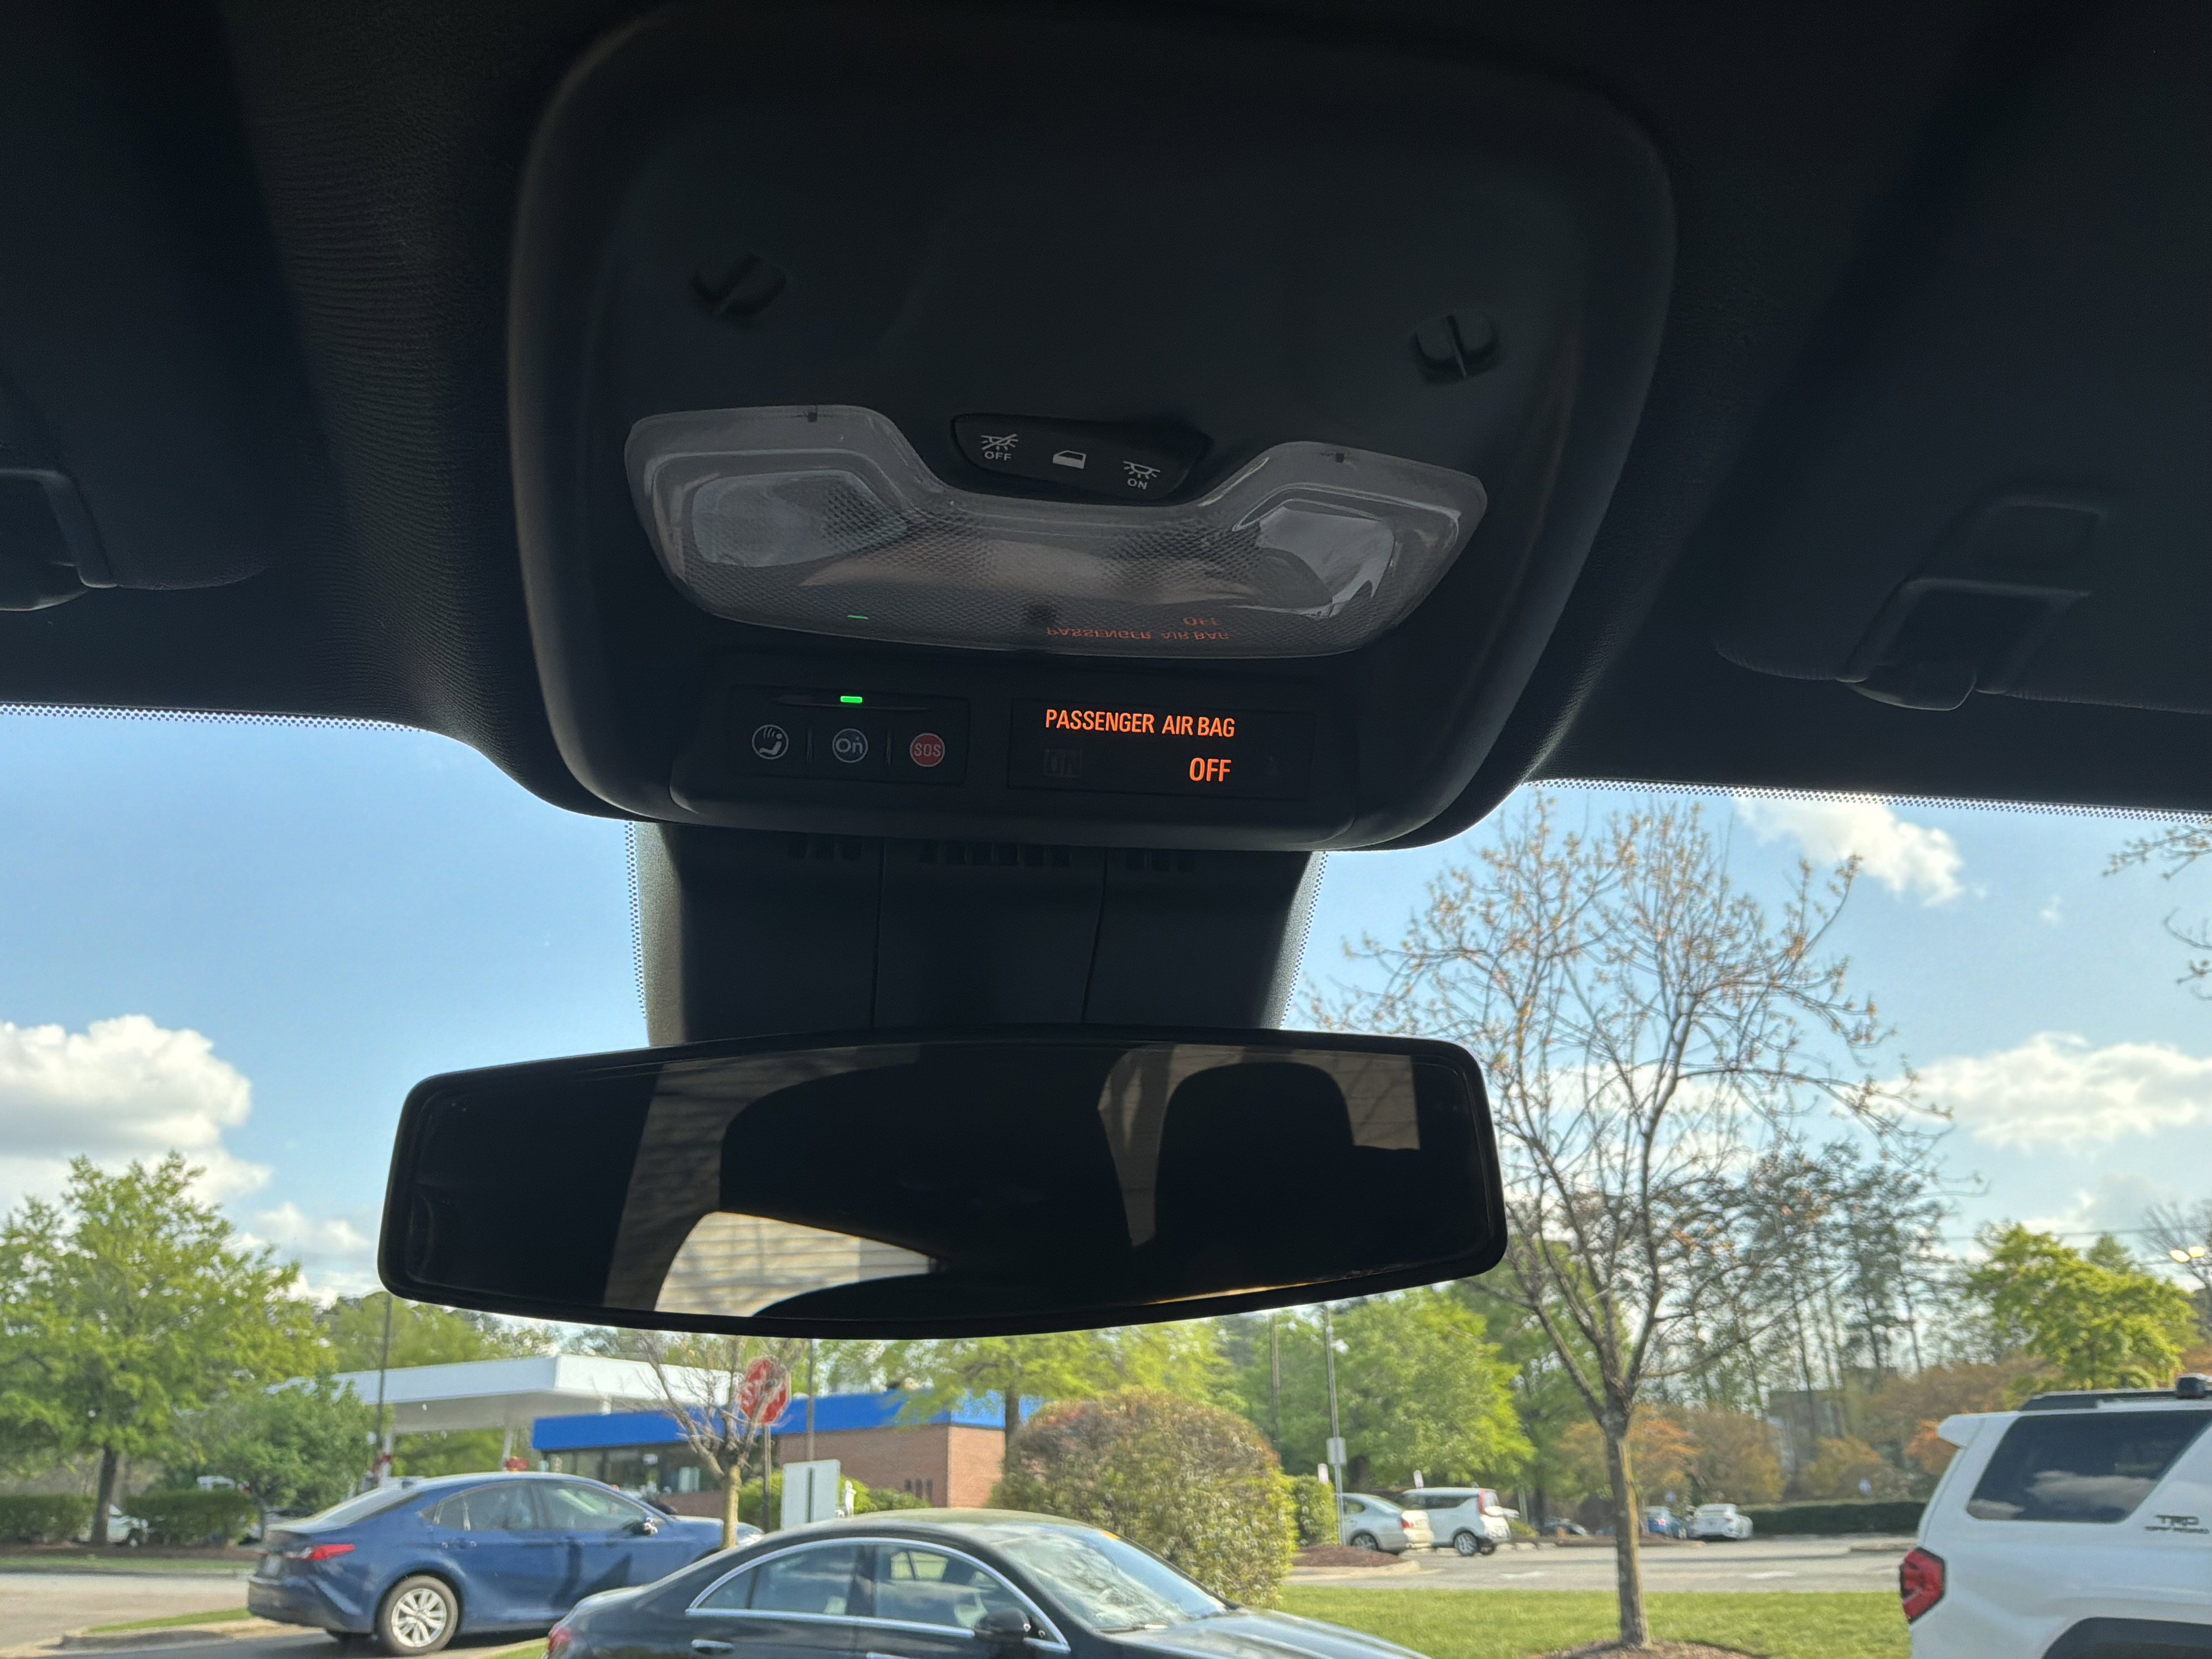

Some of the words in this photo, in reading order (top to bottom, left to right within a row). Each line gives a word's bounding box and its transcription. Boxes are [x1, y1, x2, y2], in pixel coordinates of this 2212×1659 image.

[984, 451, 1012, 461] OFF
[1127, 478, 1148, 490] ON
[1046, 709, 1155, 734] PASSENGER
[1162, 715, 1194, 736] AIR
[1198, 717, 1235, 737] BAG
[913, 742, 941, 758] SOS
[1189, 758, 1232, 782] OFF
